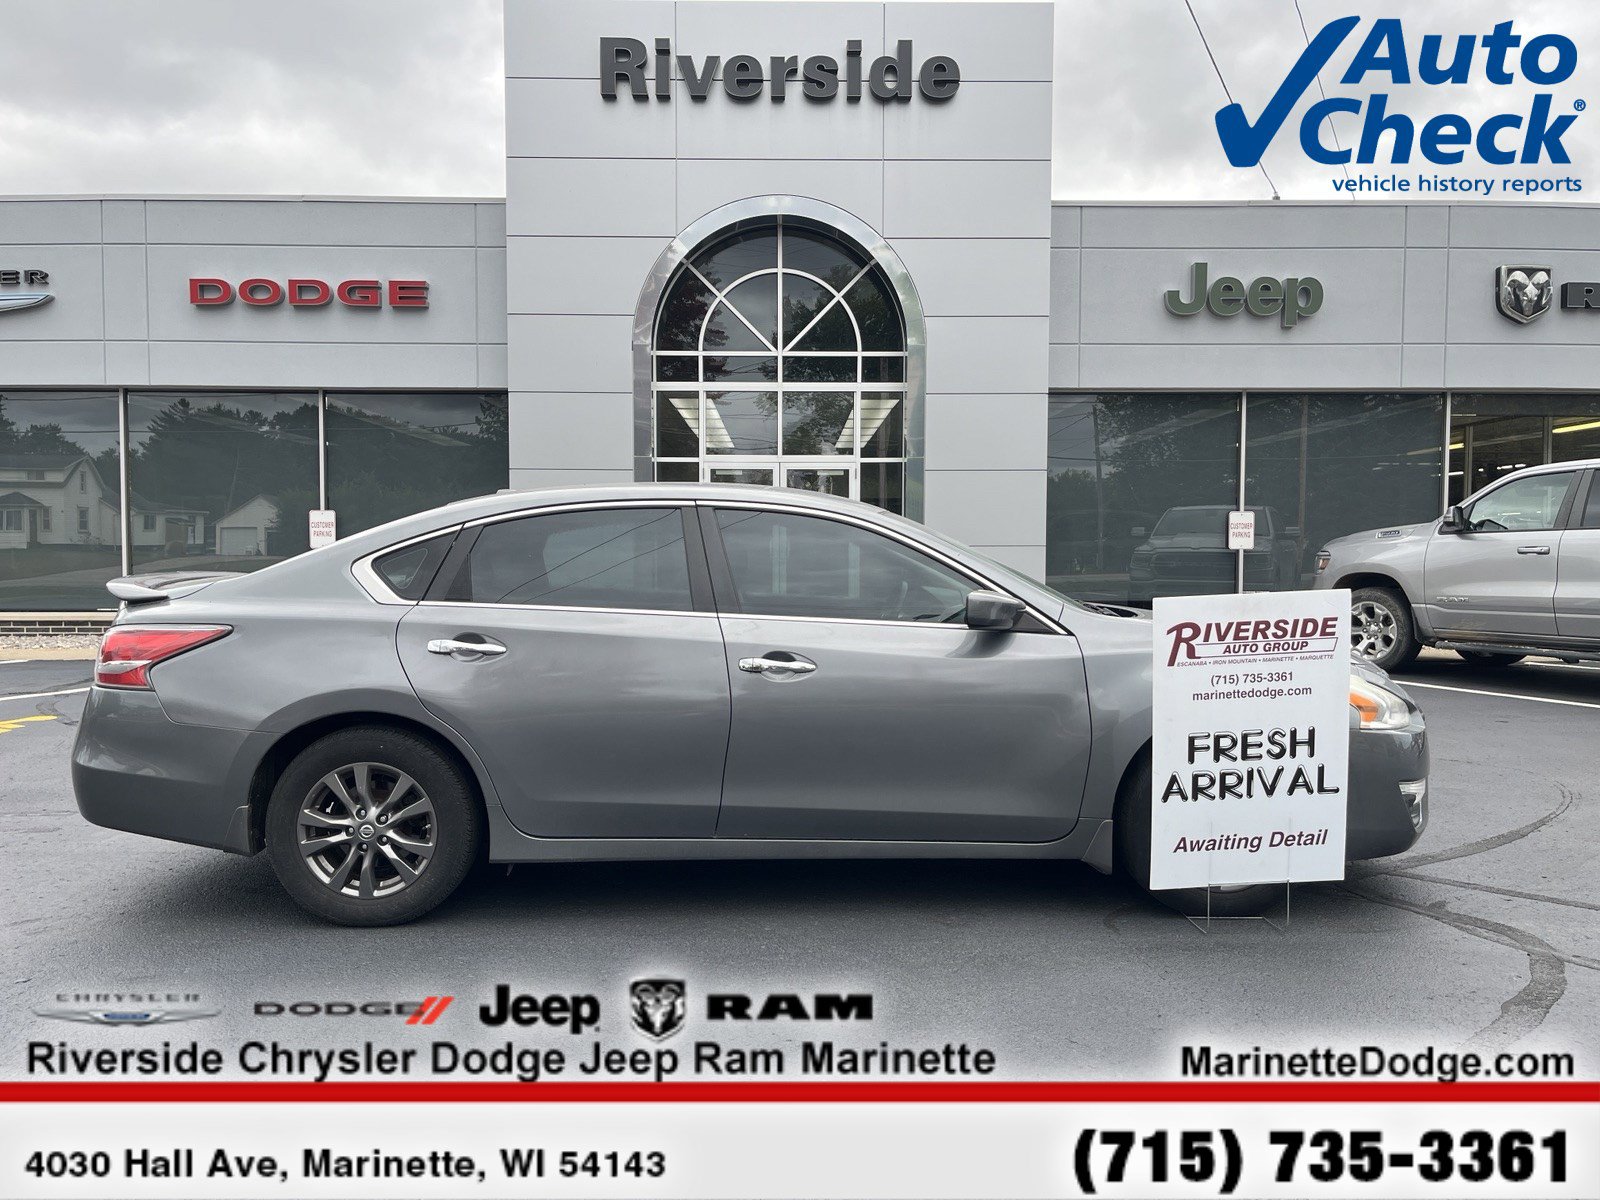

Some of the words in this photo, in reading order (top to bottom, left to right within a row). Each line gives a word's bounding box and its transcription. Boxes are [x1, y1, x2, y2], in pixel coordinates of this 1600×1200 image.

[600, 36, 961, 103] Riverside
[189, 278, 430, 309] DODGE
[1164, 262, 1324, 329] Jeep
[313, 530, 332, 538] PARKING
[1166, 616, 1339, 667] RIVERSIDE
[1223, 643, 1259, 655] AUTO
[1263, 641, 1309, 653] GROUP
[1192, 686, 1312, 702] marinettedodge.com
[1211, 674, 1240, 687] (715)
[1243, 671, 1293, 684] 735-3361
[1188, 726, 1315, 764] FRESH
[1161, 763, 1340, 803] ARRIVAL
[1173, 833, 1263, 853] Awaiting
[1269, 829, 1328, 848] Detail
